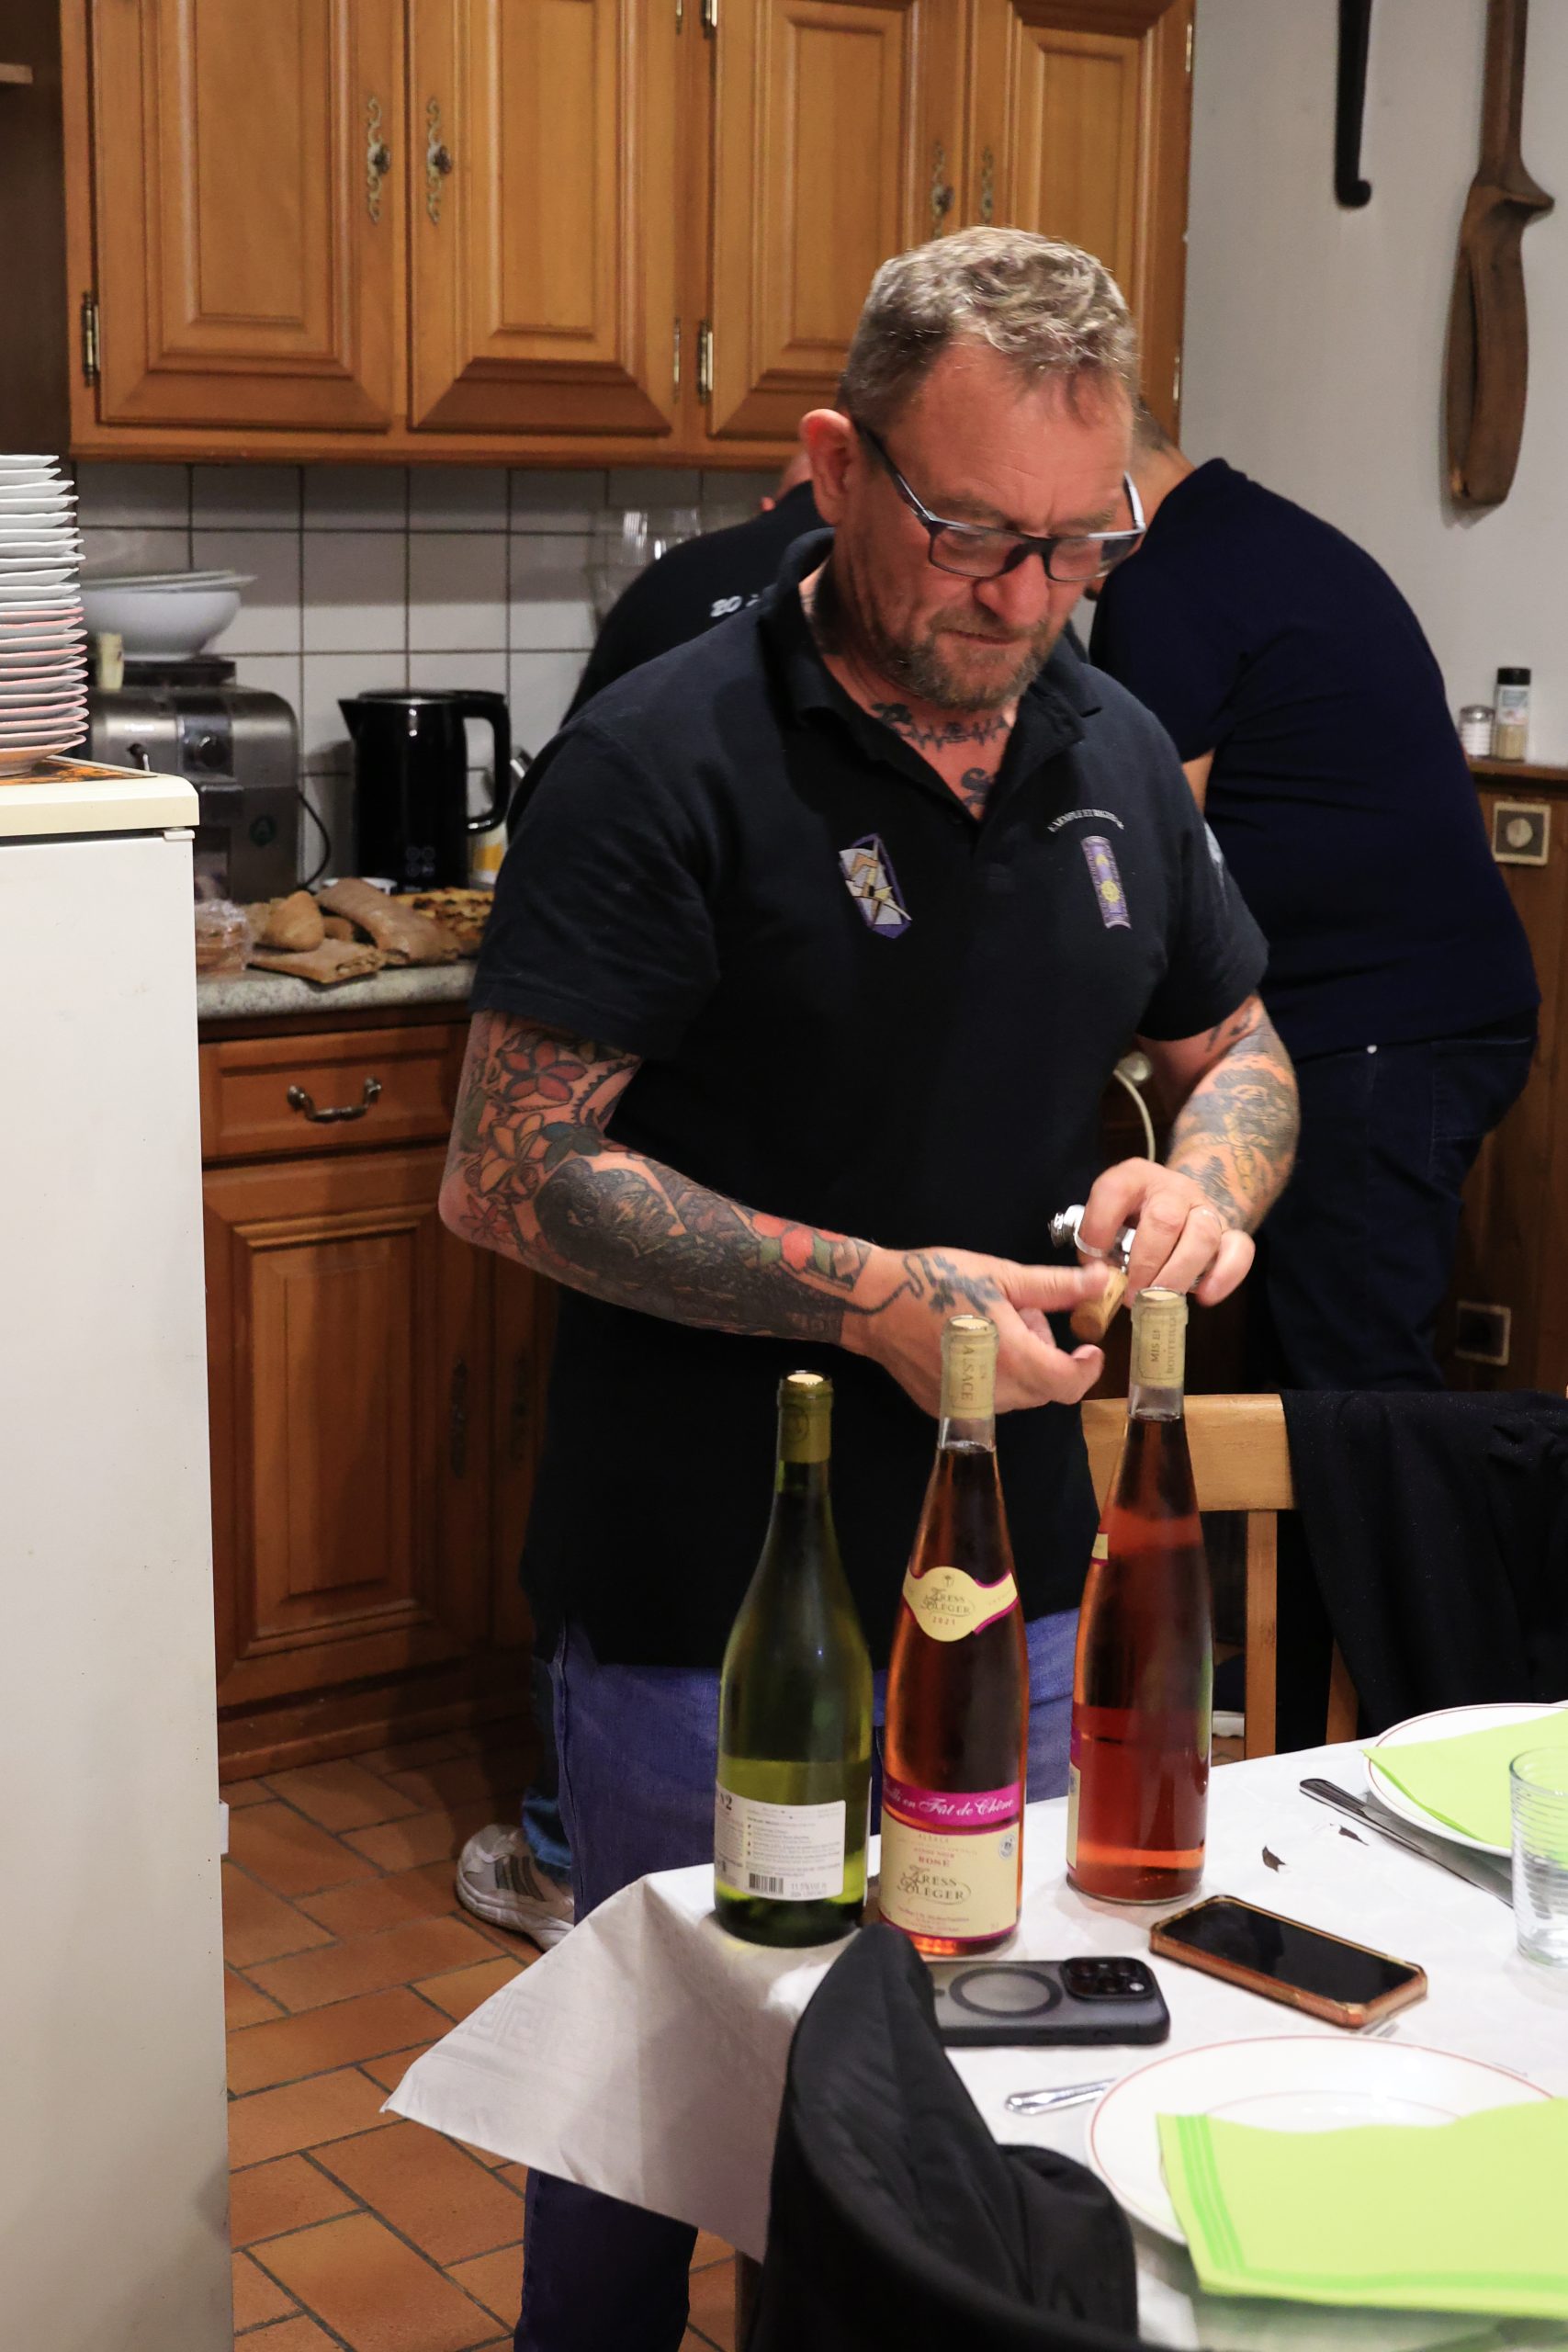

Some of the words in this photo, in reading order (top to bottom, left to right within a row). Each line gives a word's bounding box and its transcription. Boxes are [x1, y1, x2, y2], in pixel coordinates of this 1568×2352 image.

[1150, 1342, 1160, 1363] MIS
[961, 1345, 975, 1401] ALSACE
[956, 1801, 974, 1816] de
